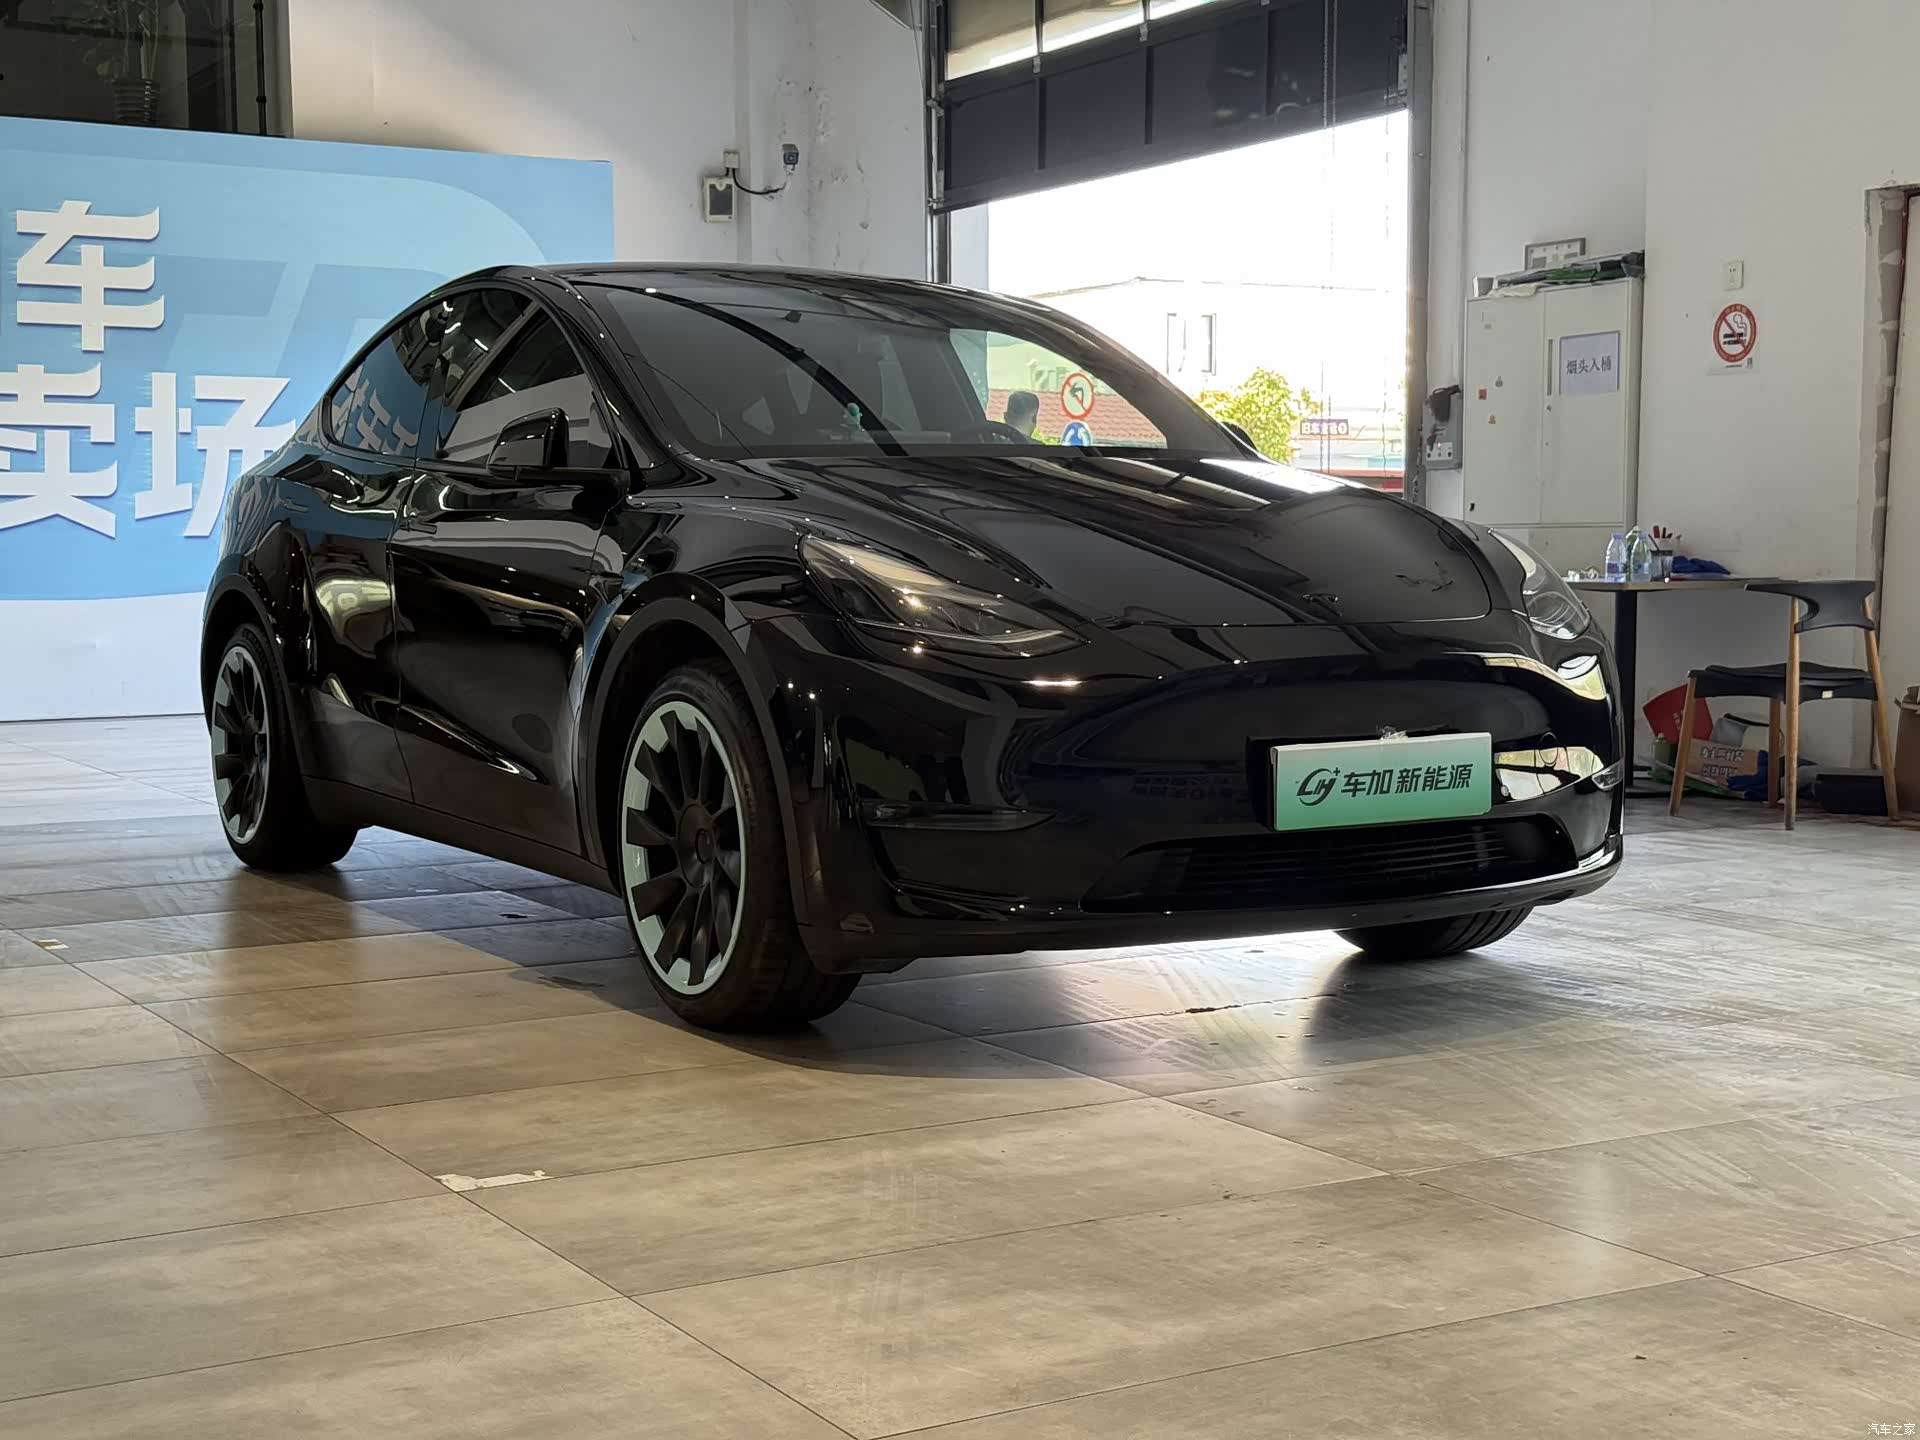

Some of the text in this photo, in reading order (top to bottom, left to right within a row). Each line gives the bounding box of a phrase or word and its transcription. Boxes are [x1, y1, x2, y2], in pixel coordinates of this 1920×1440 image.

[16, 200, 165, 353] 车
[1566, 355, 1612, 375] 烟头入桶
[1341, 763, 1473, 797] 车加新能源
